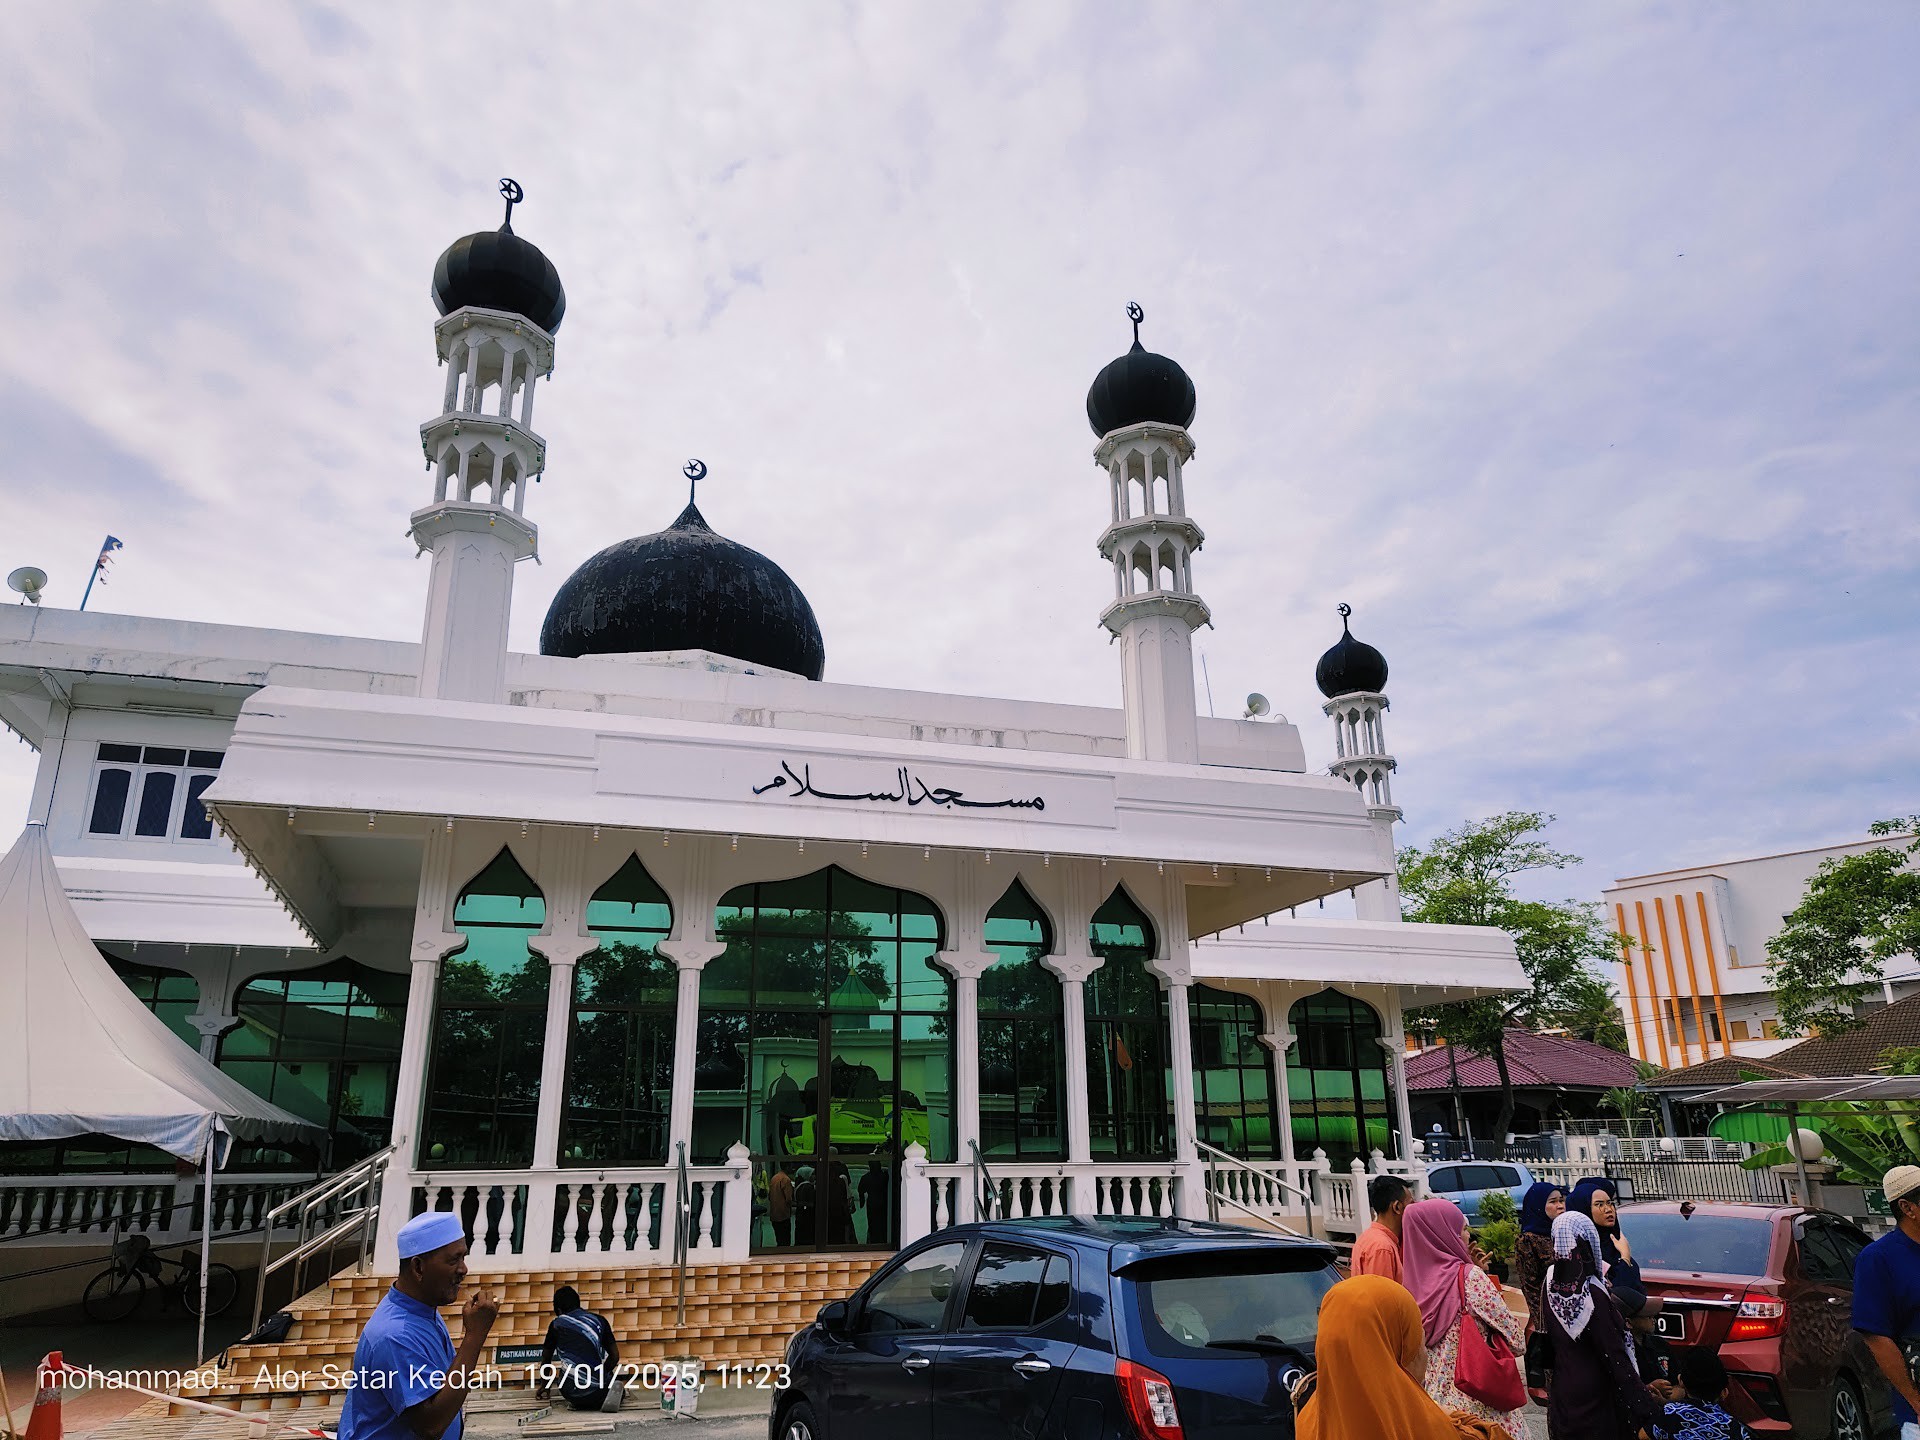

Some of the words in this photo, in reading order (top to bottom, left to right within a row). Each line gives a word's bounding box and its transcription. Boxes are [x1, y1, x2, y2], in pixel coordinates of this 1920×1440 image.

[752, 760, 911, 805] السلام
[907, 776, 1046, 811] مسجد
[500, 1350, 526, 1359] PASTIKAN
[525, 1349, 544, 1358] KASUT
